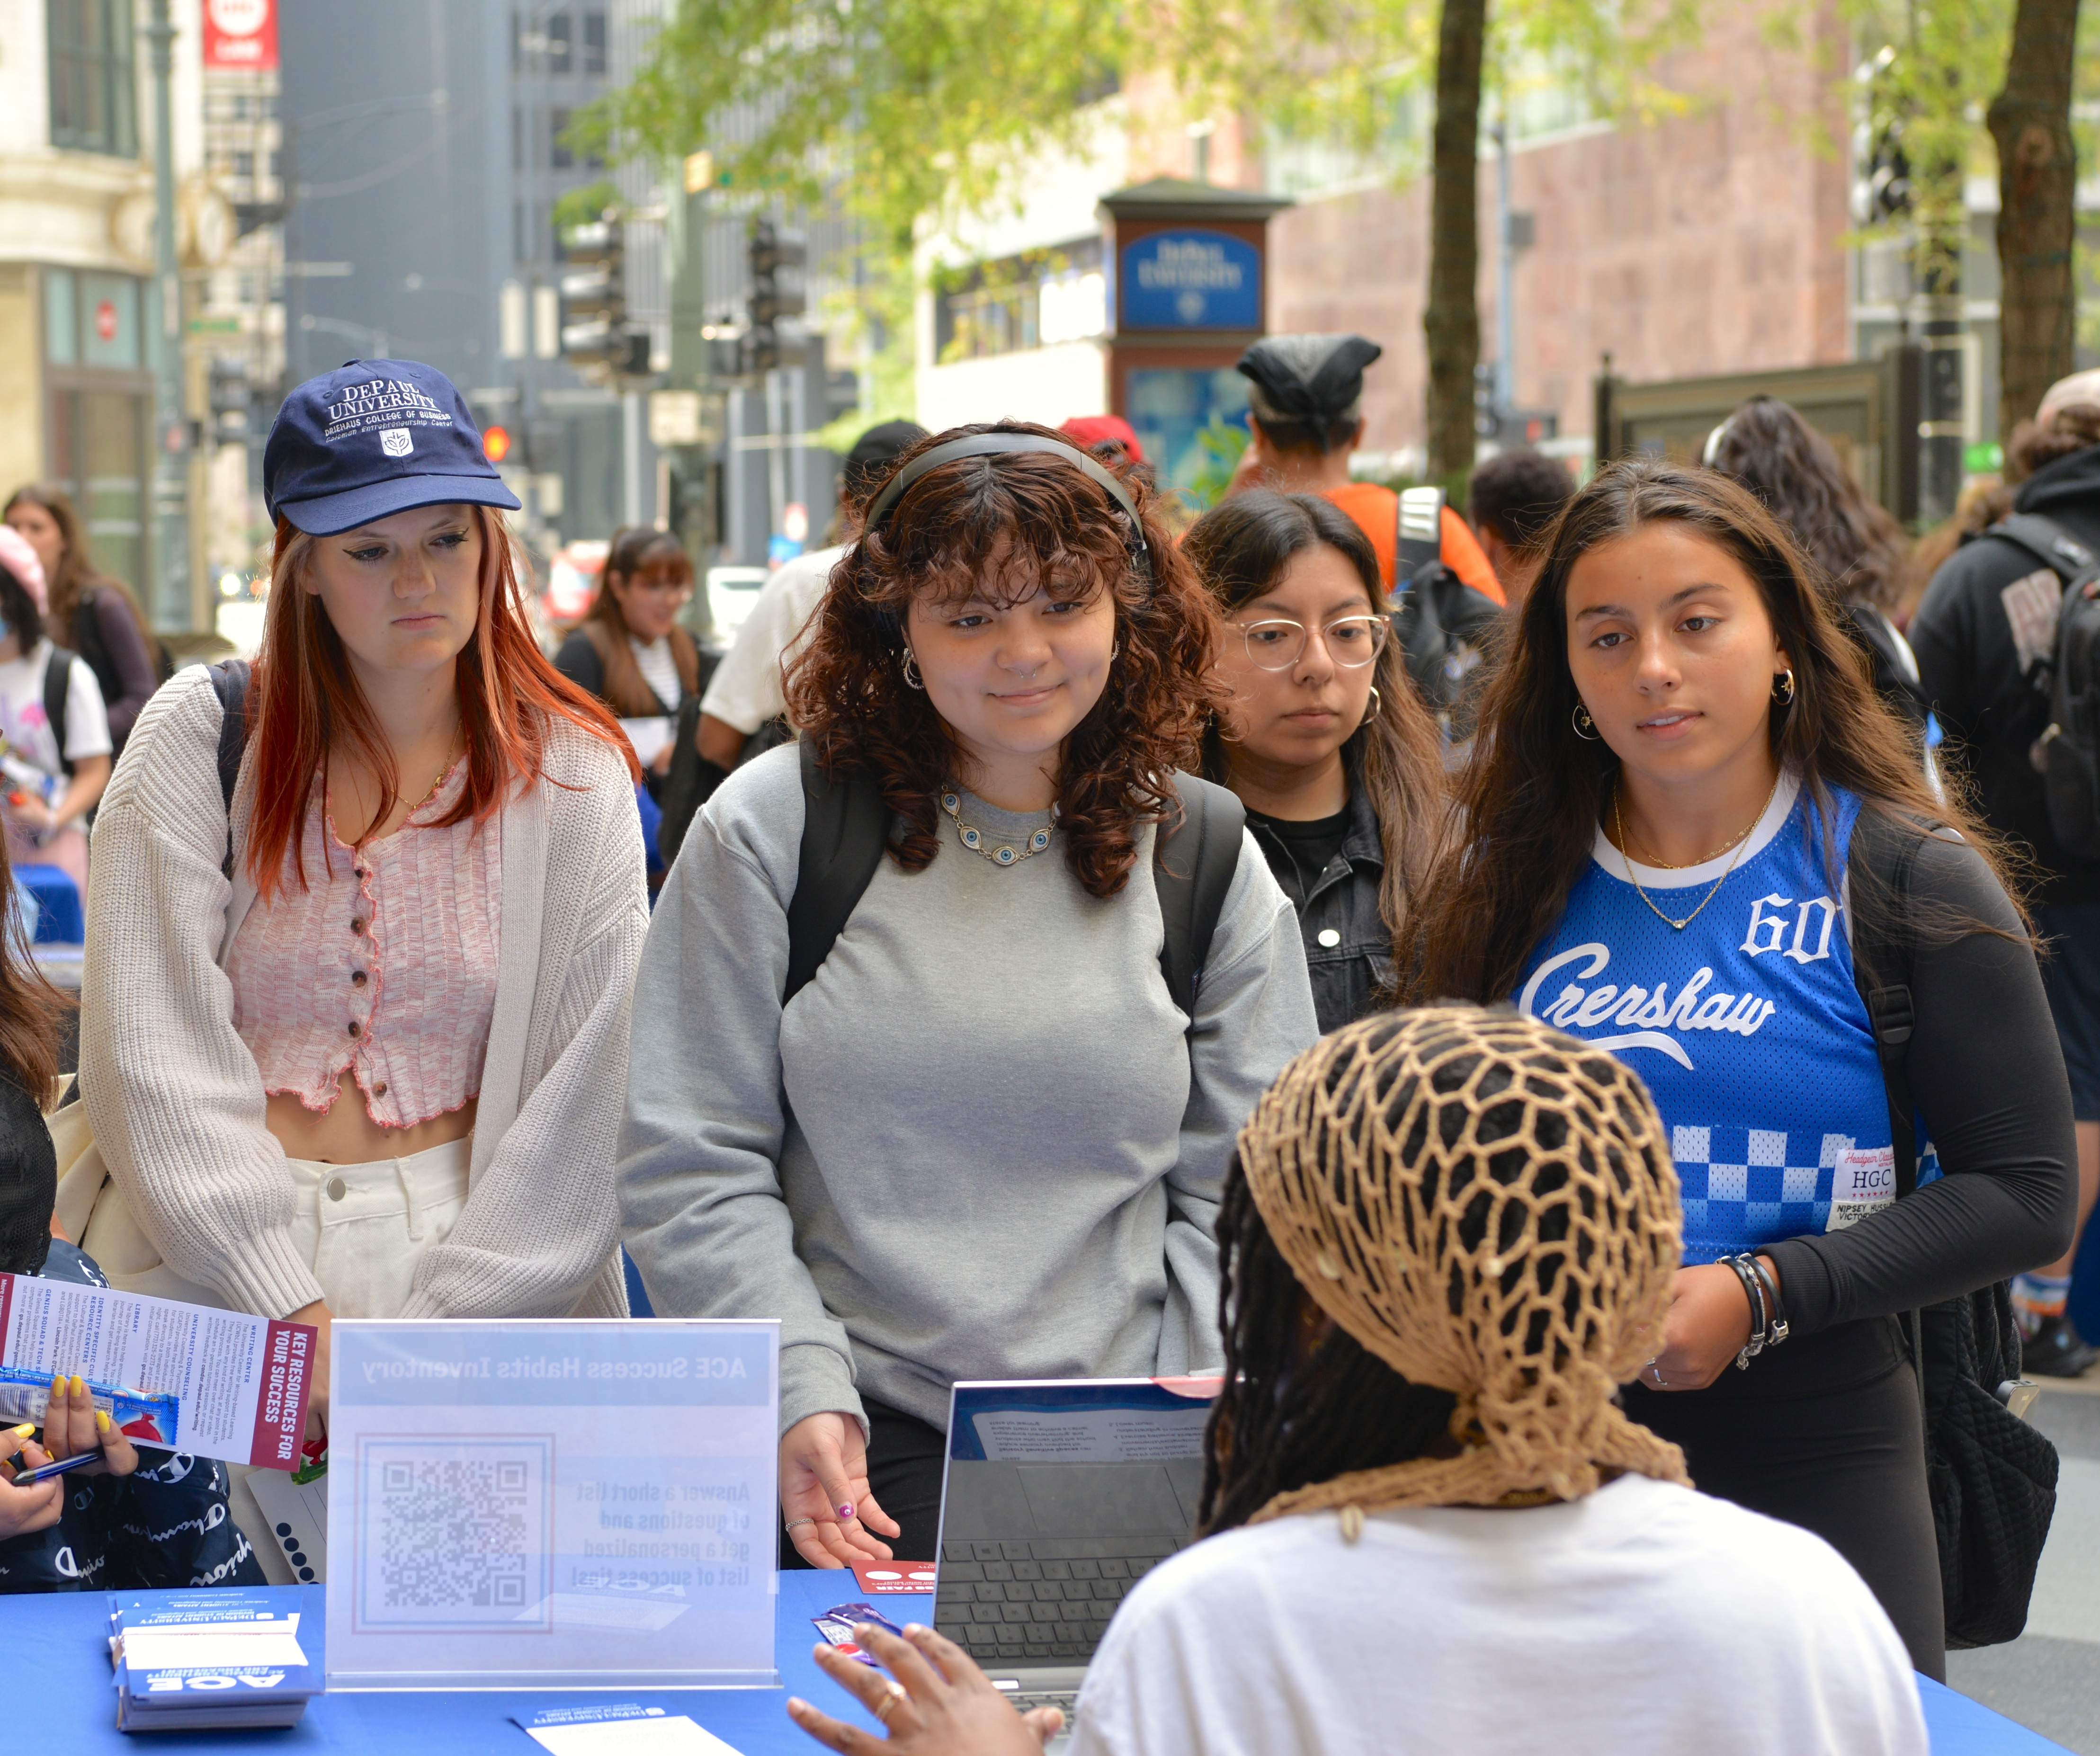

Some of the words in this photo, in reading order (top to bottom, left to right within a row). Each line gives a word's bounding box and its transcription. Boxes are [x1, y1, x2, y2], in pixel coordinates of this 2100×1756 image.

[328, 392, 437, 419] UNIVERSITY
[325, 419, 361, 437] DRIEHAUS
[366, 412, 401, 426] COLLEGE
[420, 411, 451, 420] BUSINESS
[326, 429, 357, 443] Coleman
[1739, 892, 1842, 964] 60
[1519, 943, 1775, 1036] Crenshaw
[1852, 1169, 1891, 1188] HGC
[1837, 1204, 1867, 1212] NIPSEY
[43, 1289, 51, 1314] GENIUS
[87, 1296, 96, 1331] RESOURCE
[95, 1297, 104, 1329] IDENTITY
[132, 1303, 141, 1333] LIBRARY
[182, 1312, 191, 1337] University
[159, 1324, 167, 1342] directly
[188, 1314, 198, 1355] UNIVERSITY
[238, 1333, 247, 1357] University
[248, 1325, 257, 1355] WRITING
[292, 1332, 307, 1357] KEY
[82, 1333, 91, 1363] CENTERS
[90, 1331, 99, 1362] SPECIFIC
[149, 1343, 157, 1365] 325-2273
[178, 1337, 187, 1364] Counseling
[273, 1330, 290, 1363] YOUR
[161, 1359, 170, 1382] individual
[182, 1357, 192, 1400] COUNSELING
[204, 1372, 212, 1391] tutoring
[244, 1357, 252, 1382] CENTER
[231, 1383, 240, 1417] Writing-based
[265, 1365, 285, 1423] SUCCESS
[281, 1358, 304, 1432] RESOURCES
[227, 1418, 235, 1439] Learning
[277, 1435, 293, 1459] FOR
[147, 1674, 285, 1692] ACE
